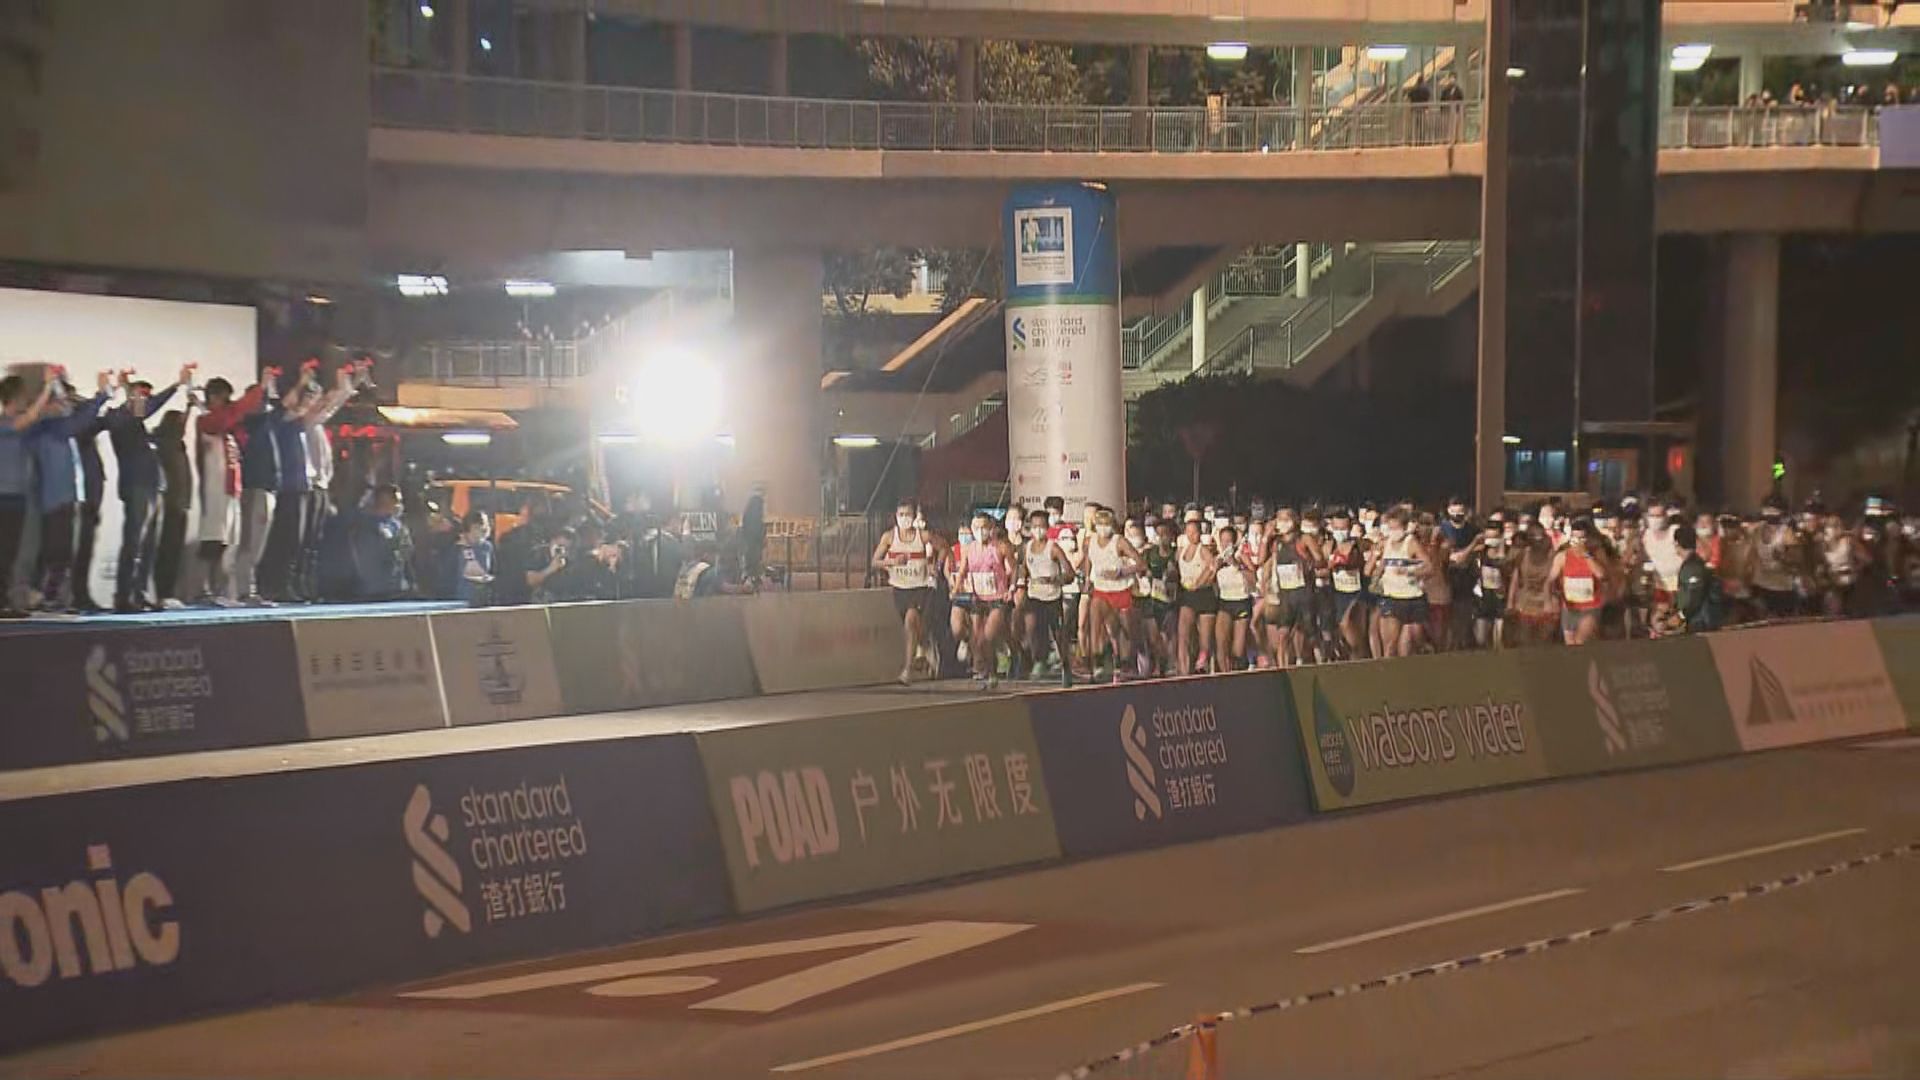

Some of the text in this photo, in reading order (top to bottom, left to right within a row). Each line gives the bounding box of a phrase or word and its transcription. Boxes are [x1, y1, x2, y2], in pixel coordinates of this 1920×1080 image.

[1152, 703, 1217, 737] standard
[1348, 694, 1526, 769] watsons water
[1160, 733, 1228, 769] chartered
[460, 772, 572, 827] standard
[730, 765, 840, 868] POAD
[471, 818, 588, 869] chartered
[0, 843, 180, 987] onic
[481, 871, 566, 922] 渣打銀行
